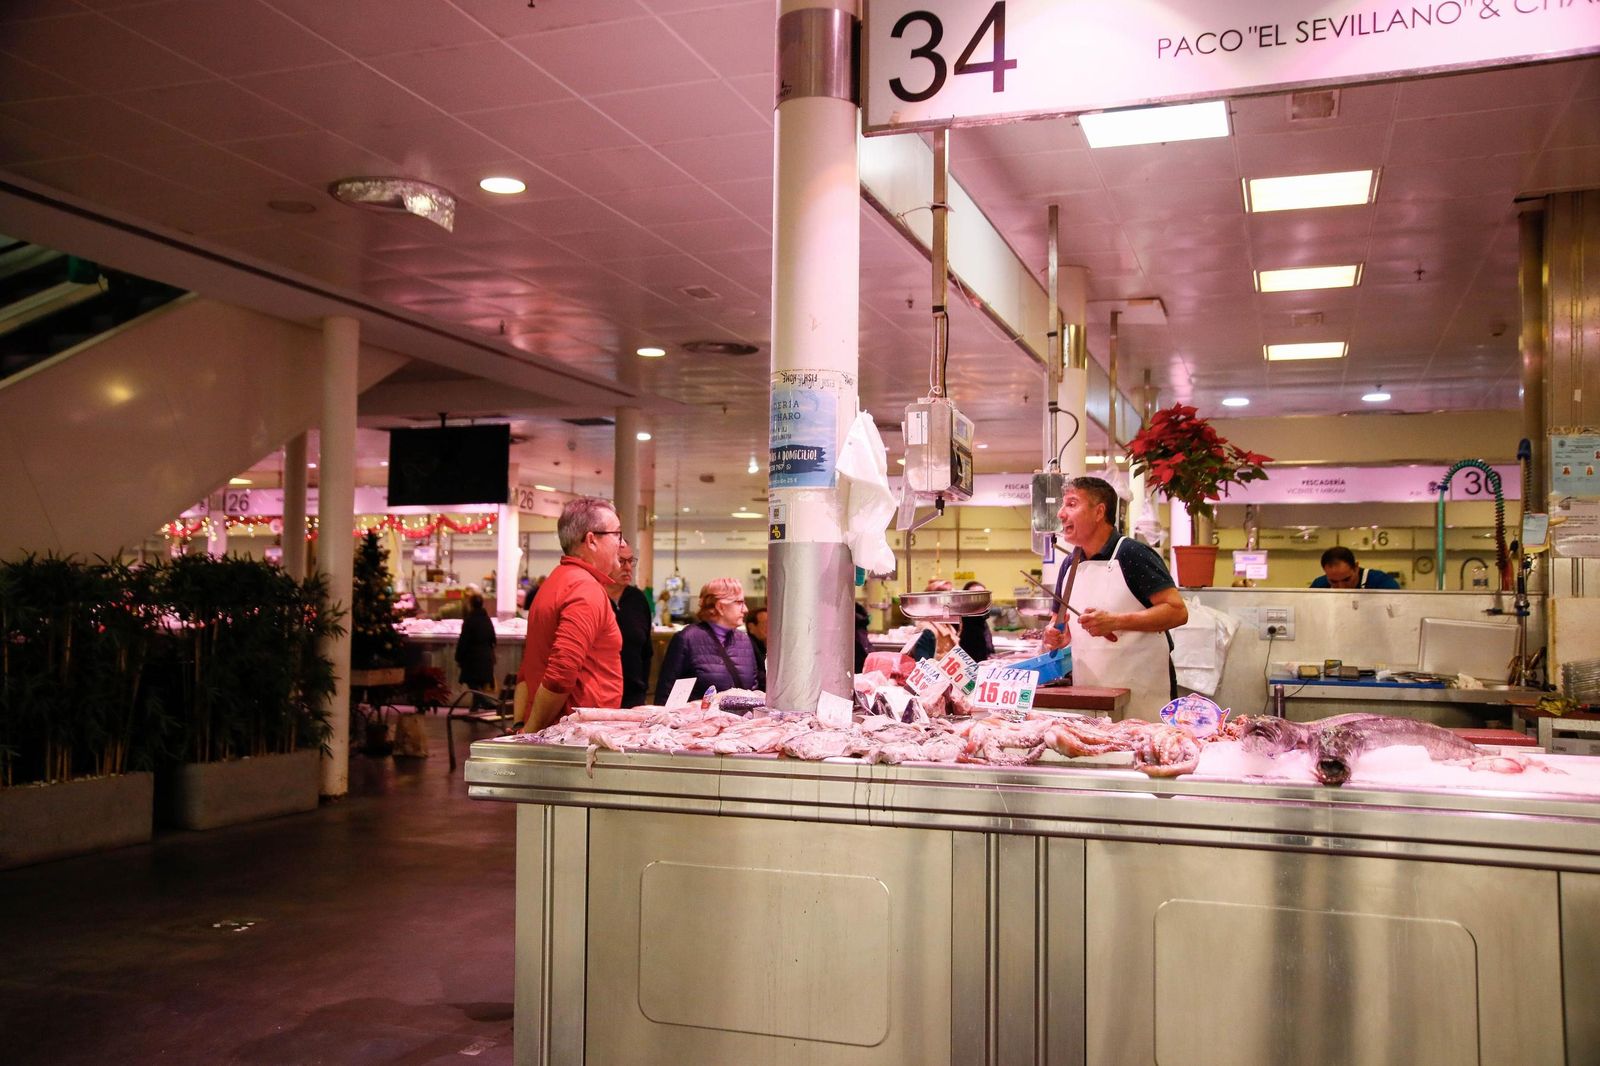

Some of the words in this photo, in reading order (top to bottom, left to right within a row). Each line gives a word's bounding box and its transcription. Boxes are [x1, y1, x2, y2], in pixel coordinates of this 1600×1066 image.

[888, 0, 1018, 103] 34
[1157, 29, 1243, 59] PACO
[228, 493, 250, 512] 26
[520, 490, 534, 510] 26
[1377, 531, 1389, 546] 6
